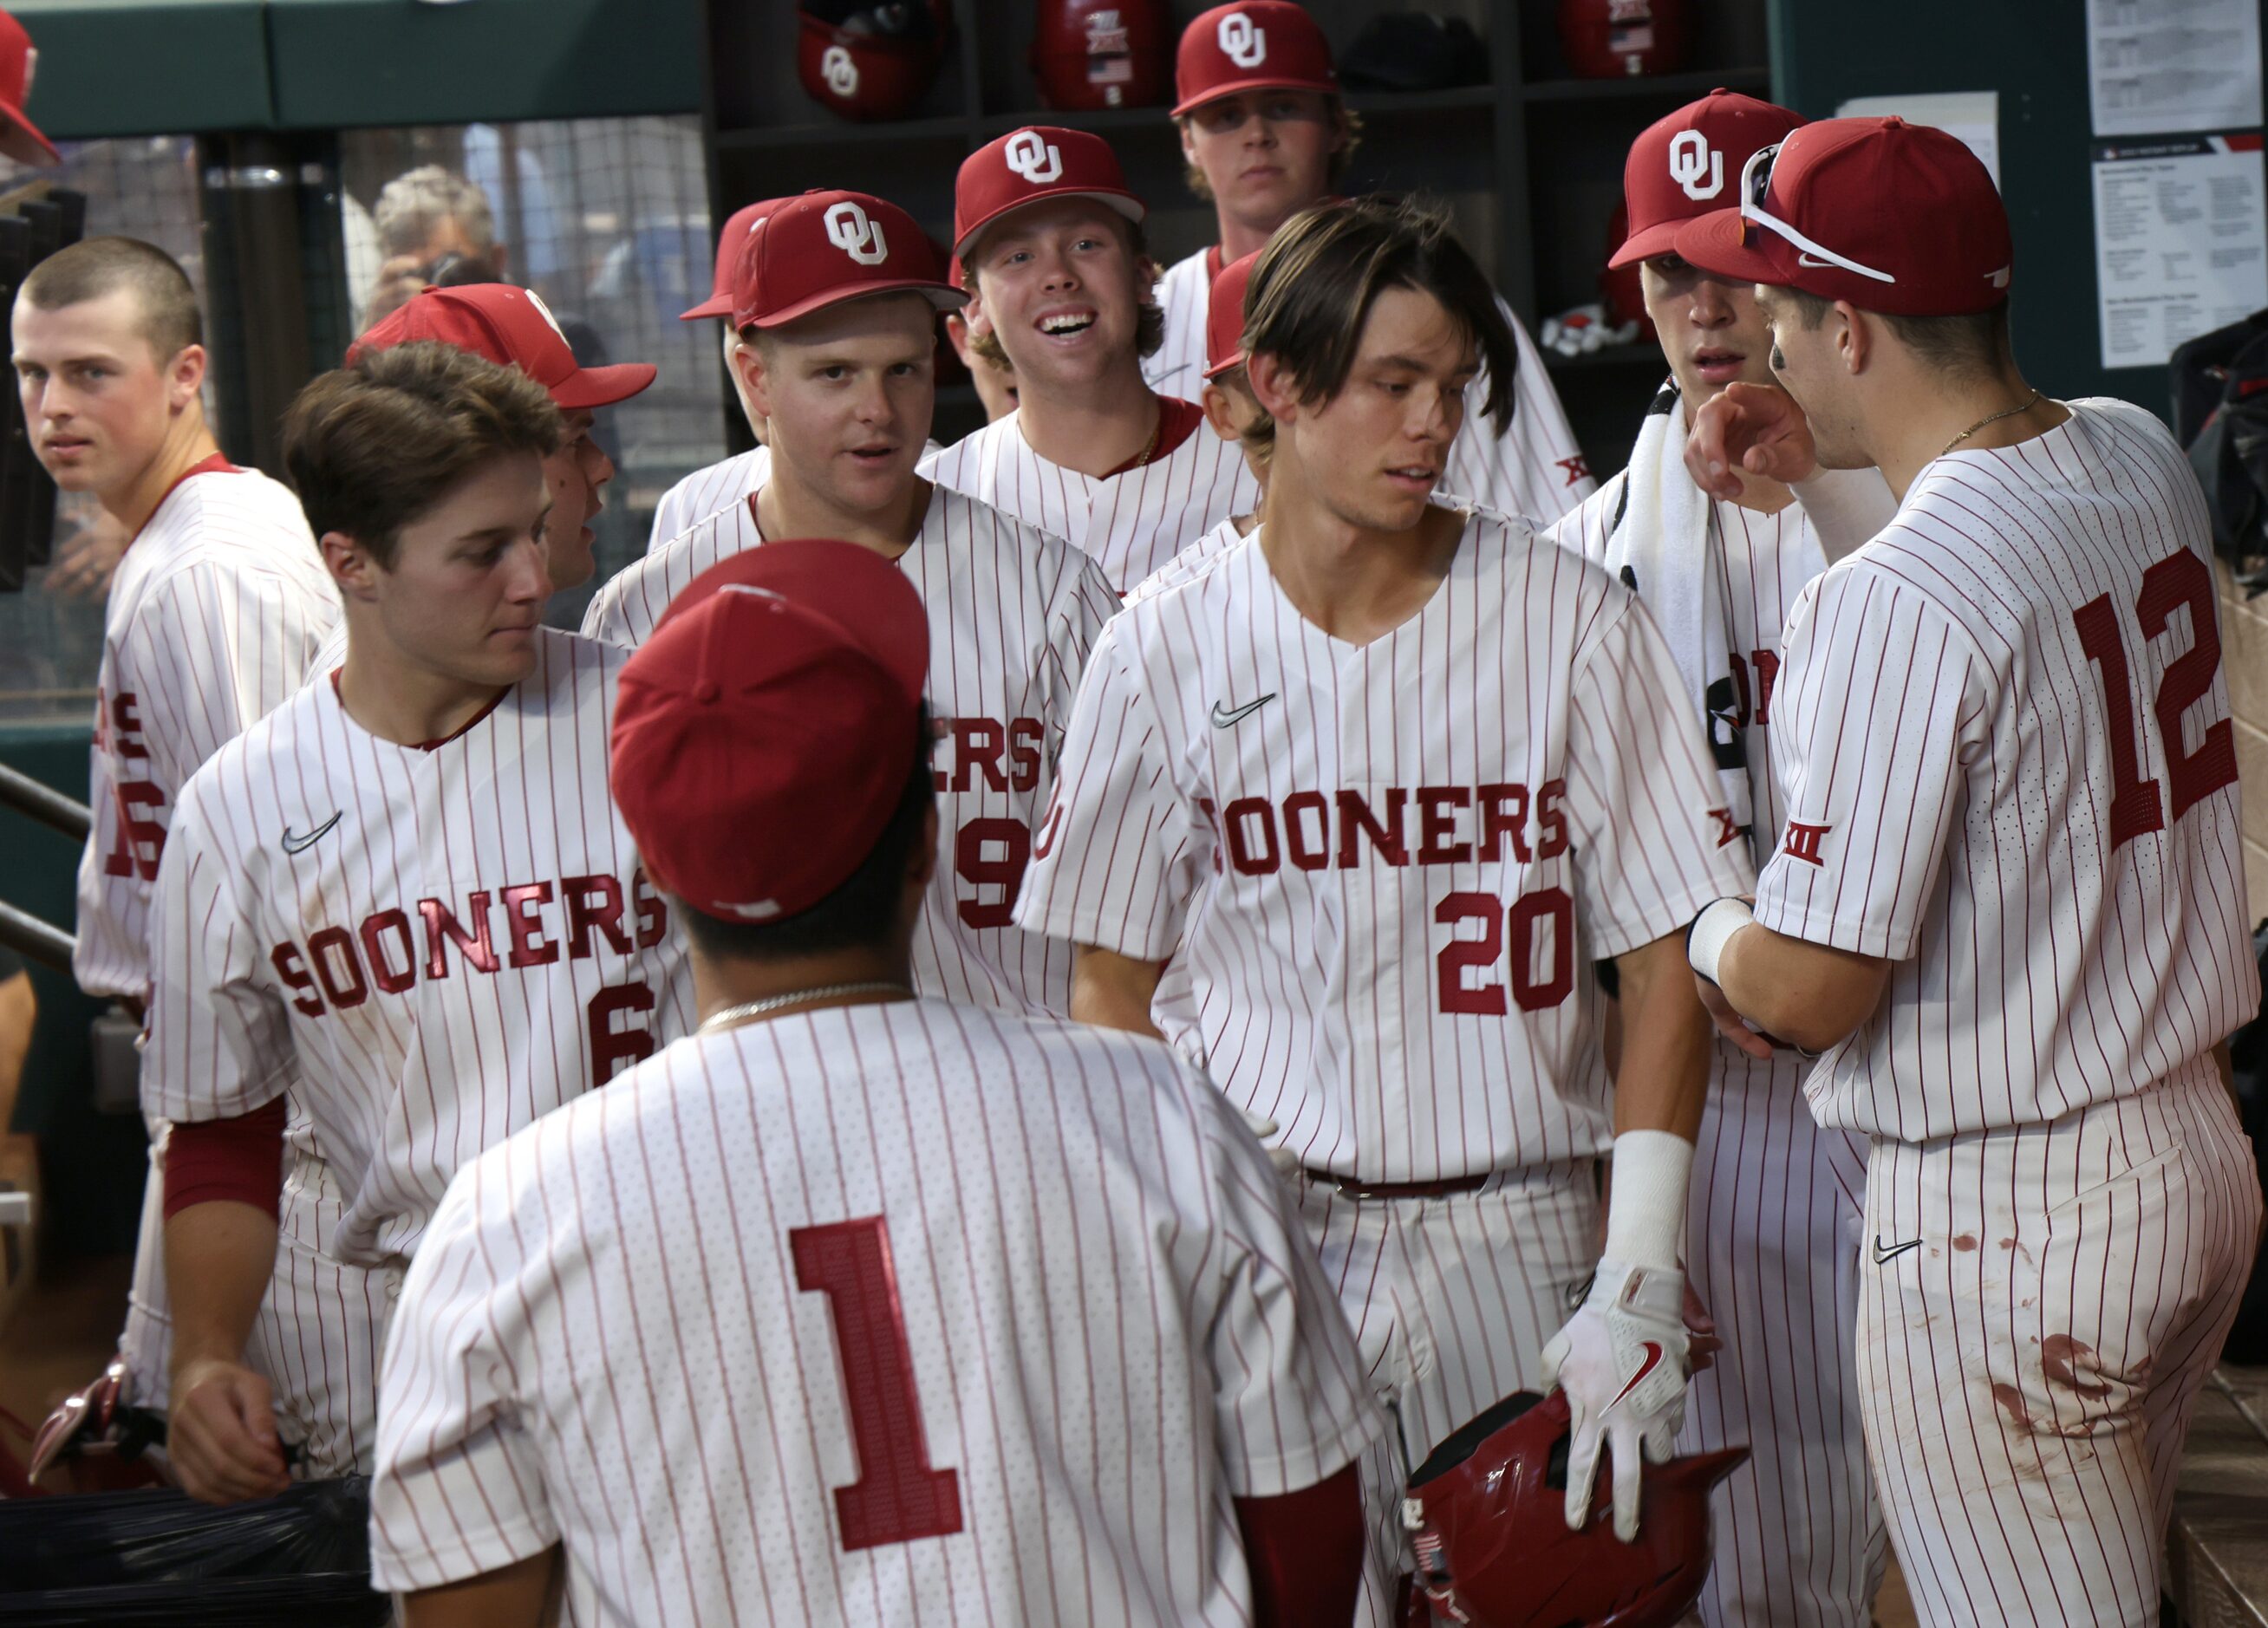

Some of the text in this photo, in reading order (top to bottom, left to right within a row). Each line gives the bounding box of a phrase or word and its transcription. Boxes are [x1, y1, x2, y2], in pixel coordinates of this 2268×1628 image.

[822, 46, 858, 96] OU
[1217, 11, 1267, 68] OU
[1005, 130, 1063, 183] OU
[1669, 129, 1724, 200] OU
[823, 200, 888, 264] OU
[2073, 544, 2239, 856] 12
[955, 817, 1031, 929] 9
[270, 867, 667, 1019] SOONERS
[1435, 886, 1574, 1016] 20
[789, 1213, 963, 1553] 1
